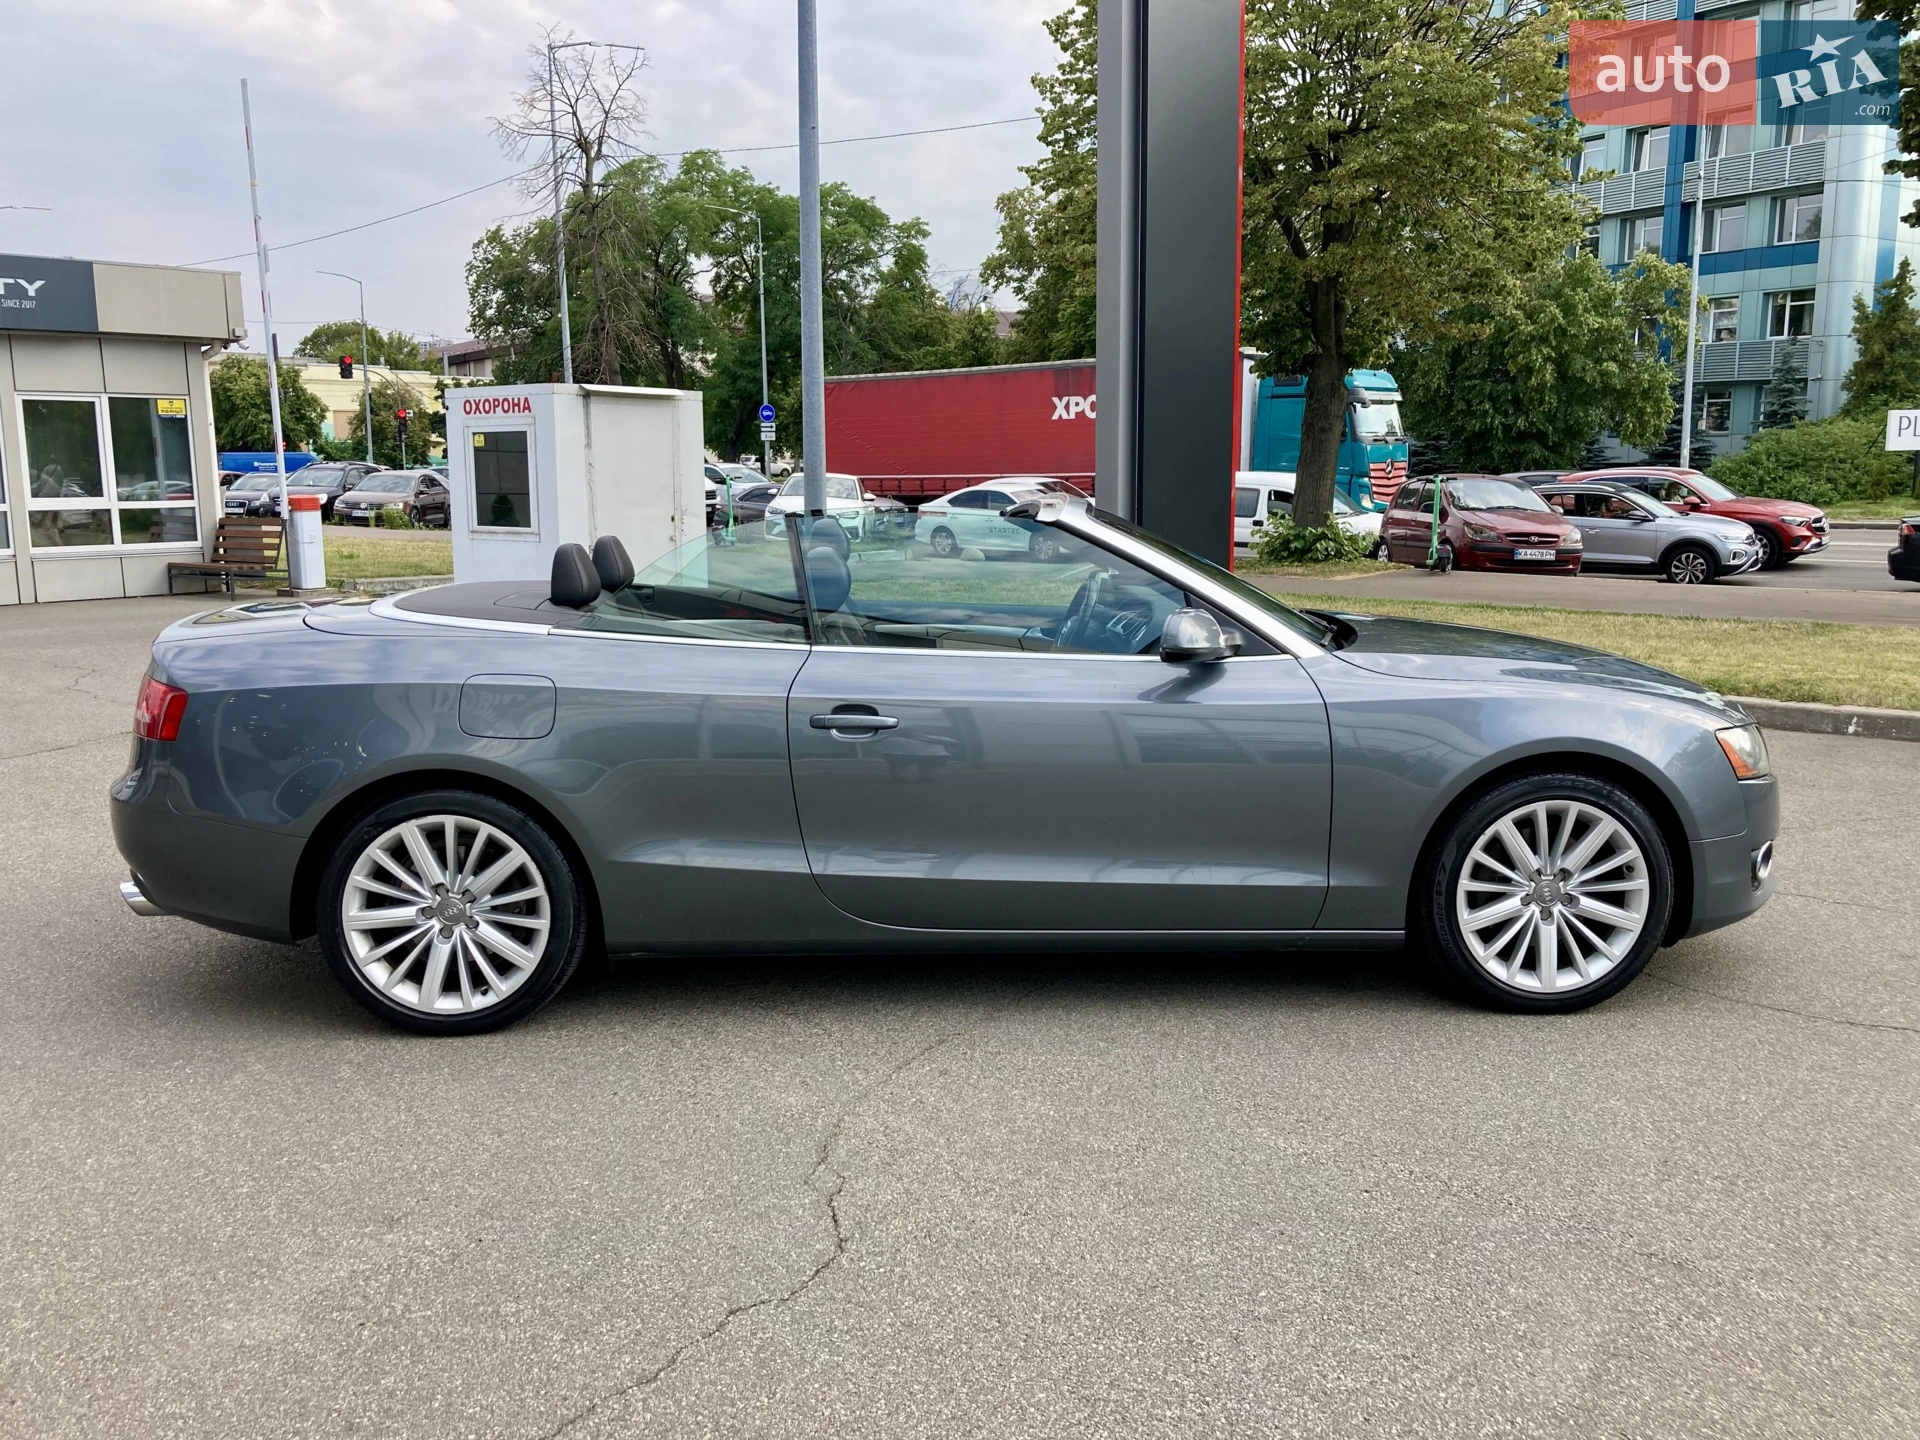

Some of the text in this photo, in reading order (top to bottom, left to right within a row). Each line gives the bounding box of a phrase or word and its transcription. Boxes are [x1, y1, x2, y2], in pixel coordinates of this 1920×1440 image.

[1, 298, 36, 308] SINCE 2017
[463, 397, 532, 415] ОХОРОНА
